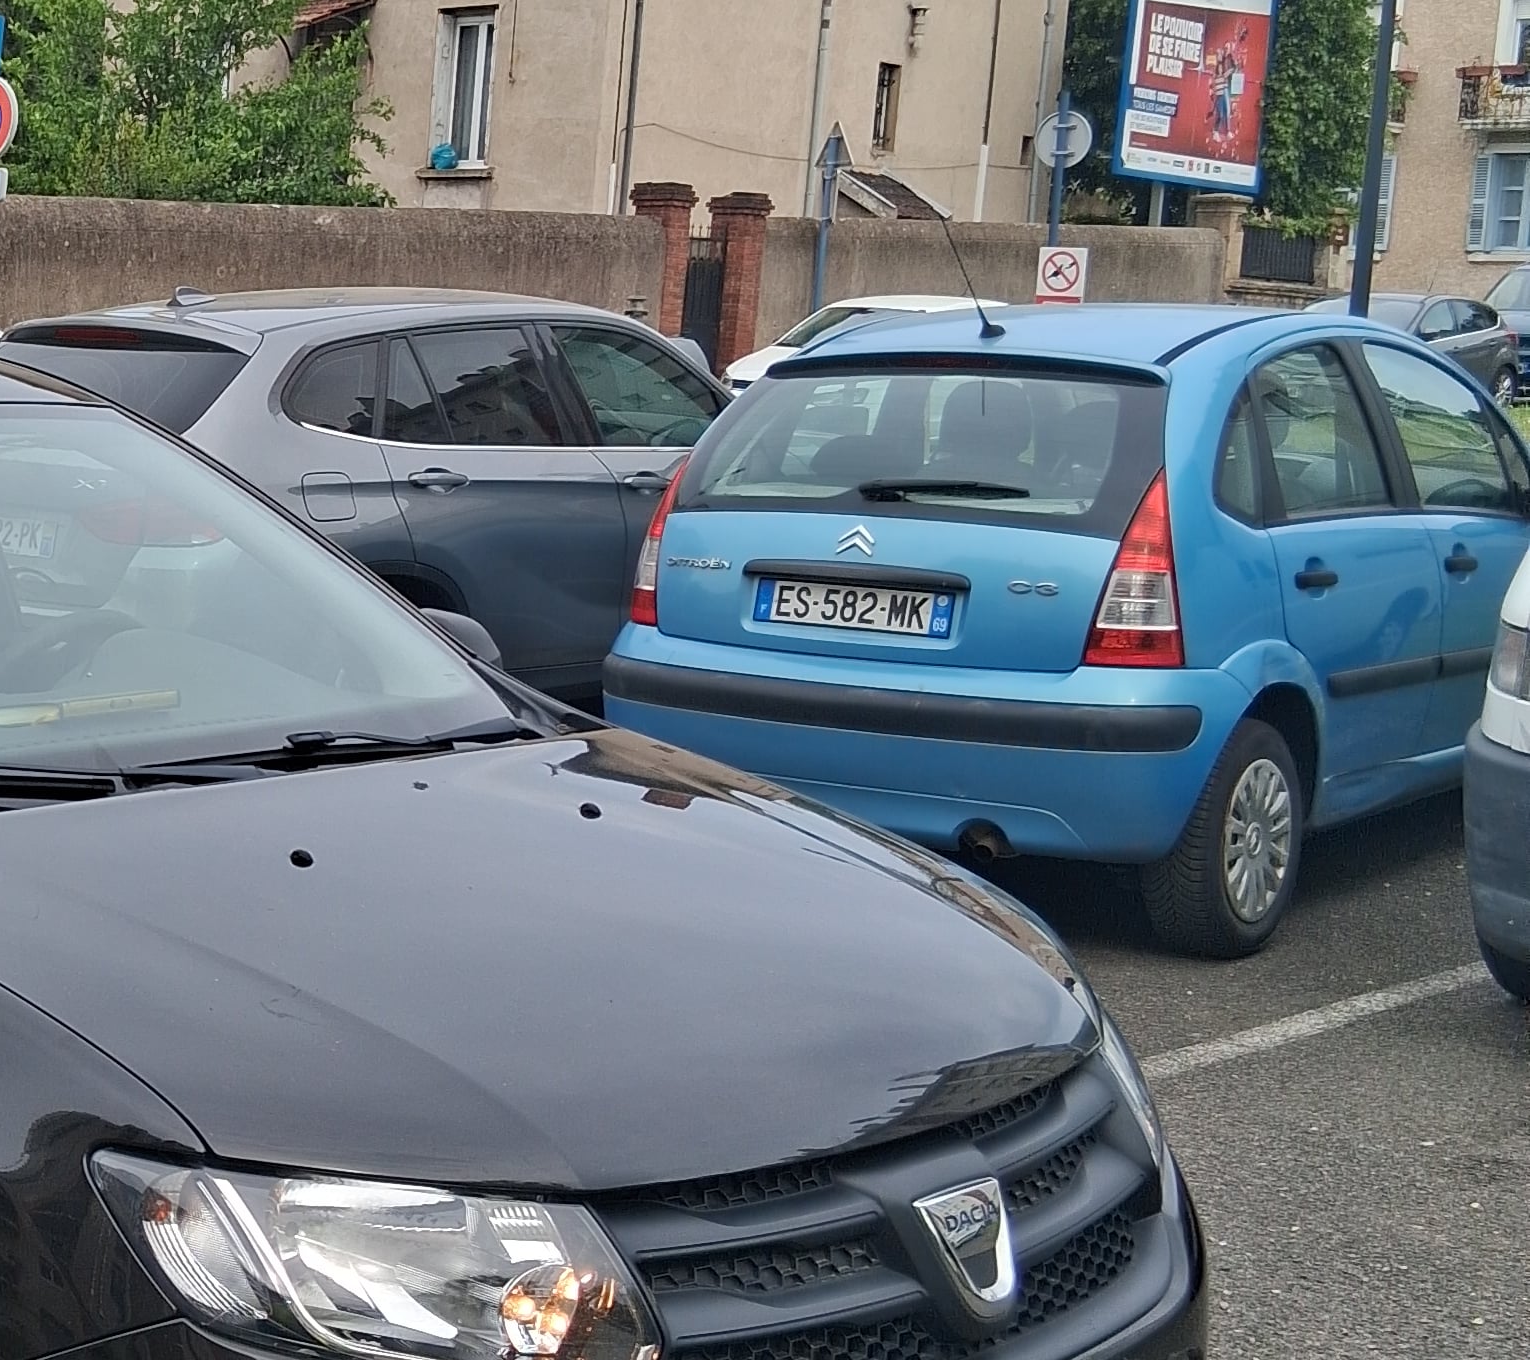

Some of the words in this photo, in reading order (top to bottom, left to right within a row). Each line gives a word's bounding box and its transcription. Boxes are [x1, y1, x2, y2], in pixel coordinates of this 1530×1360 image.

[1150, 12, 1164, 33] LE
[1164, 15, 1204, 42] POUVOIR
[1148, 33, 1162, 54] DE
[1161, 37, 1175, 56] SE
[1173, 39, 1201, 62] FAIRE
[1145, 54, 1183, 78] PLAISIR
[666, 556, 733, 570] CITROËN
[1007, 580, 1060, 597] C3
[775, 585, 929, 630] ES-582-MK
[932, 617, 947, 633] 69
[945, 1200, 999, 1233] DACIA
